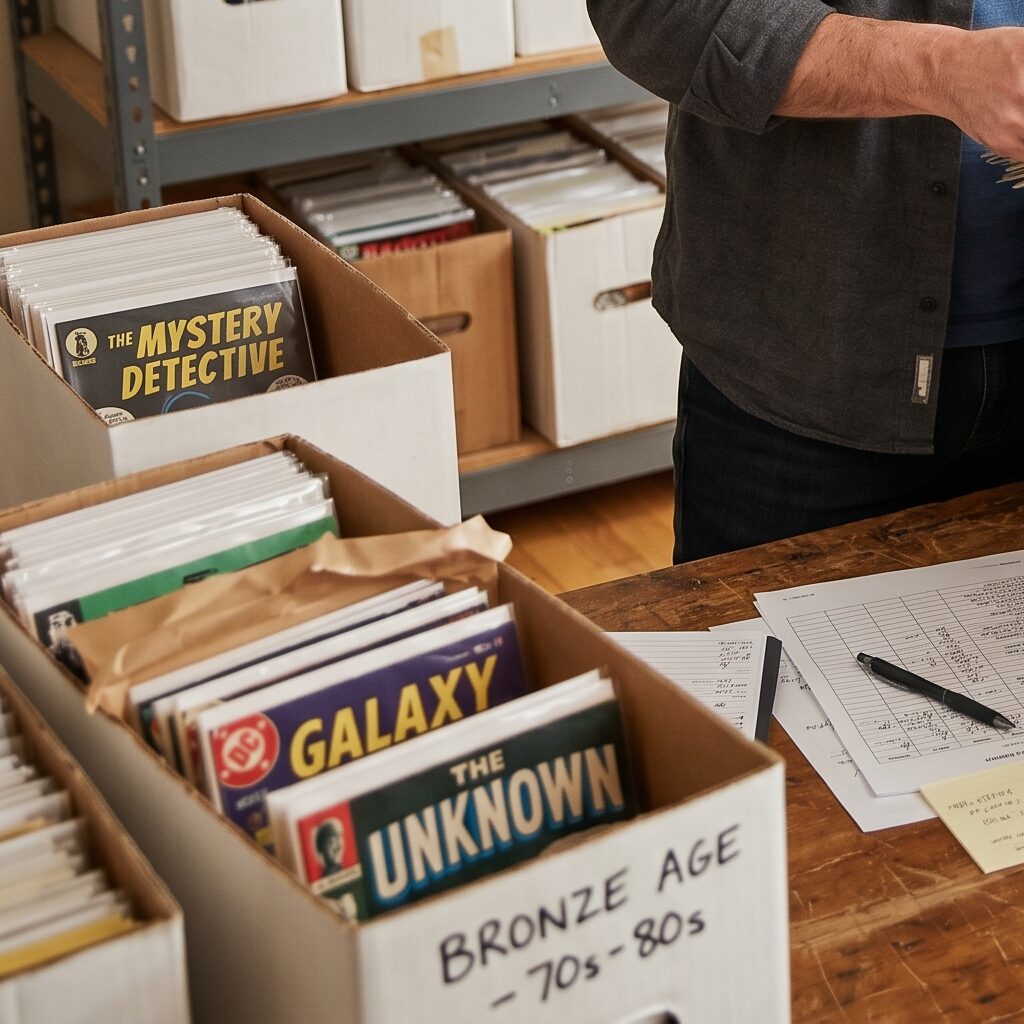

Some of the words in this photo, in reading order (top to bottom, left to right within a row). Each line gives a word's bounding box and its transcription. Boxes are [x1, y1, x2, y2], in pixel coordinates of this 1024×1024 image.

[107, 331, 133, 350] THE
[136, 301, 282, 359] MYSTERY
[121, 337, 284, 401] DETECTIVE
[227, 728, 260, 768] DC
[290, 654, 498, 778] GALAXY
[450, 748, 505, 786] THE
[367, 743, 625, 904] UNKNOWN
[439, 866, 630, 984] BRONZE
[656, 823, 741, 893] AGE
